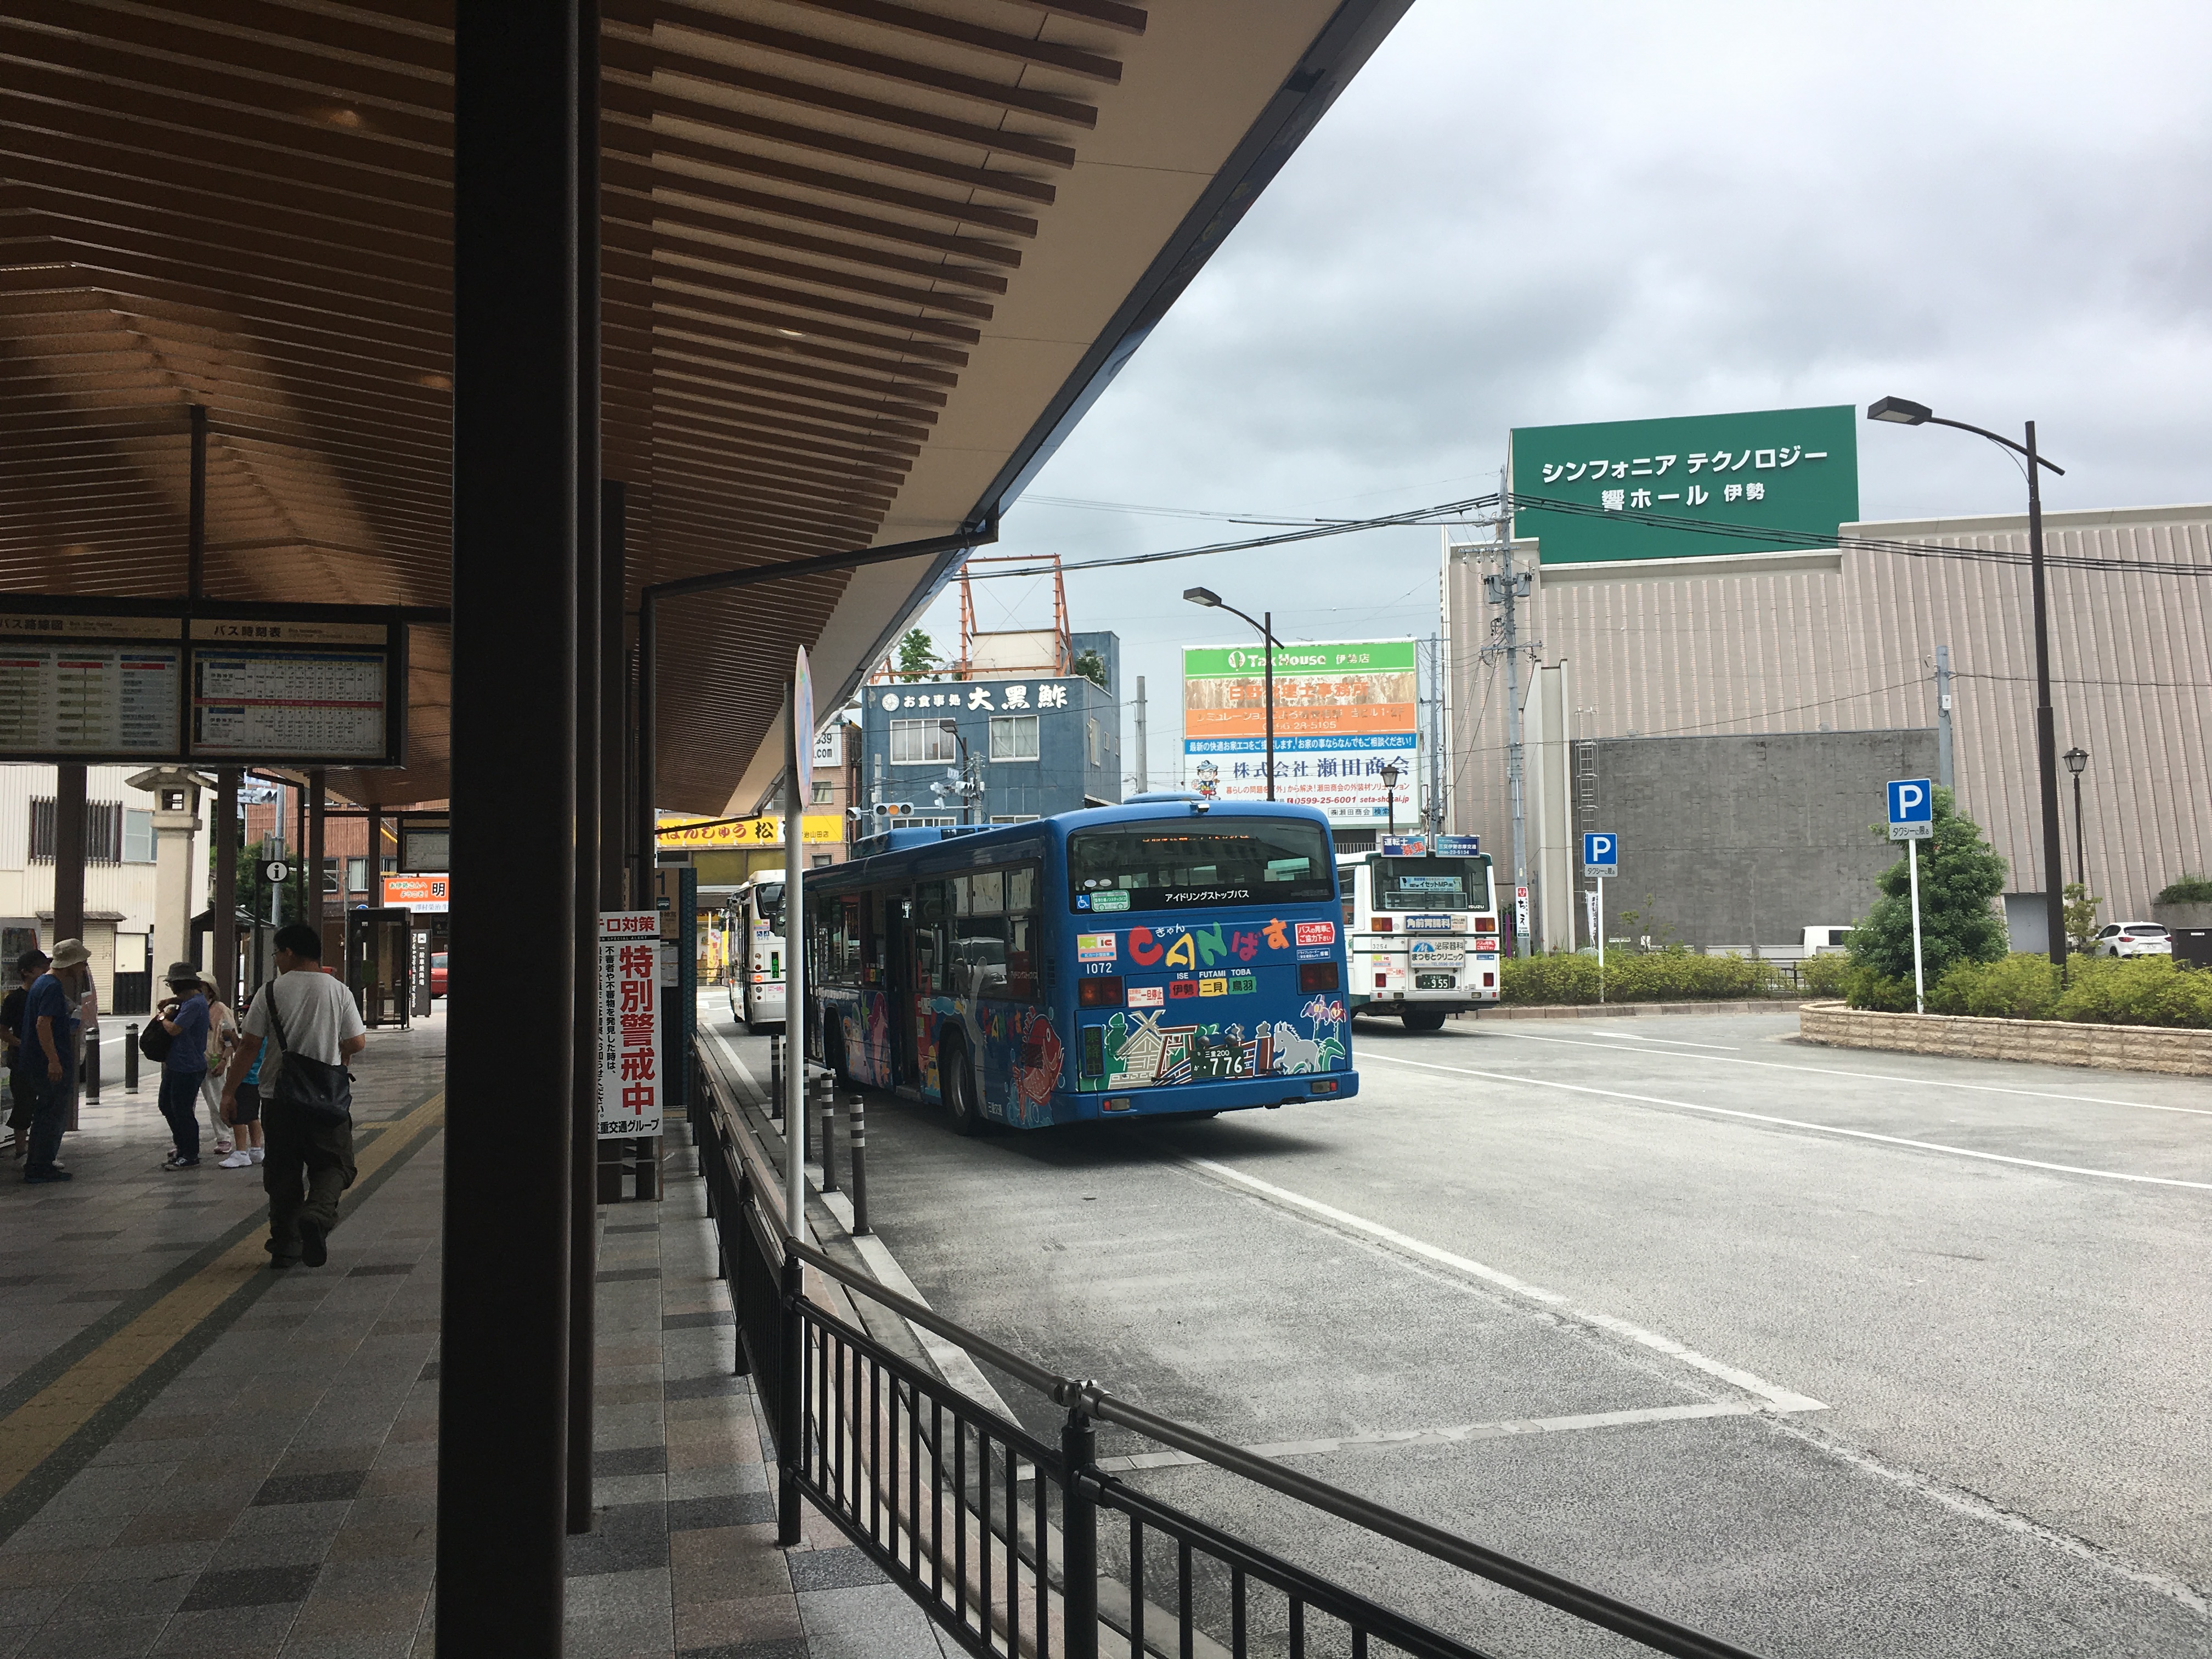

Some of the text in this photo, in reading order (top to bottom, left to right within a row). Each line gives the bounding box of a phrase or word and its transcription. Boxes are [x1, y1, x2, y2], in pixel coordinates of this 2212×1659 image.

[1542, 445, 1827, 483] シンフォニア テクノロジー
[1601, 483, 1765, 512] 響ホール 伊勢
[904, 694, 961, 708] お食事処
[1360, 795, 1409, 804] seta-shoai.jp
[1899, 785, 1923, 819] P
[1892, 825, 1929, 837] タクシーに限る
[1593, 837, 1611, 862] P
[1165, 890, 1250, 902] アイドリングストップバス
[1155, 923, 1186, 938] きゃん
[1412, 953, 1464, 961] まつもとクリニック
[1086, 962, 1113, 974] 1072
[1173, 980, 1253, 996] 伊勢 二見 鳥羽
[605, 946, 616, 1074] 不審者や不審物を発見した時は、
[619, 944, 655, 1116] 特別警戒中
